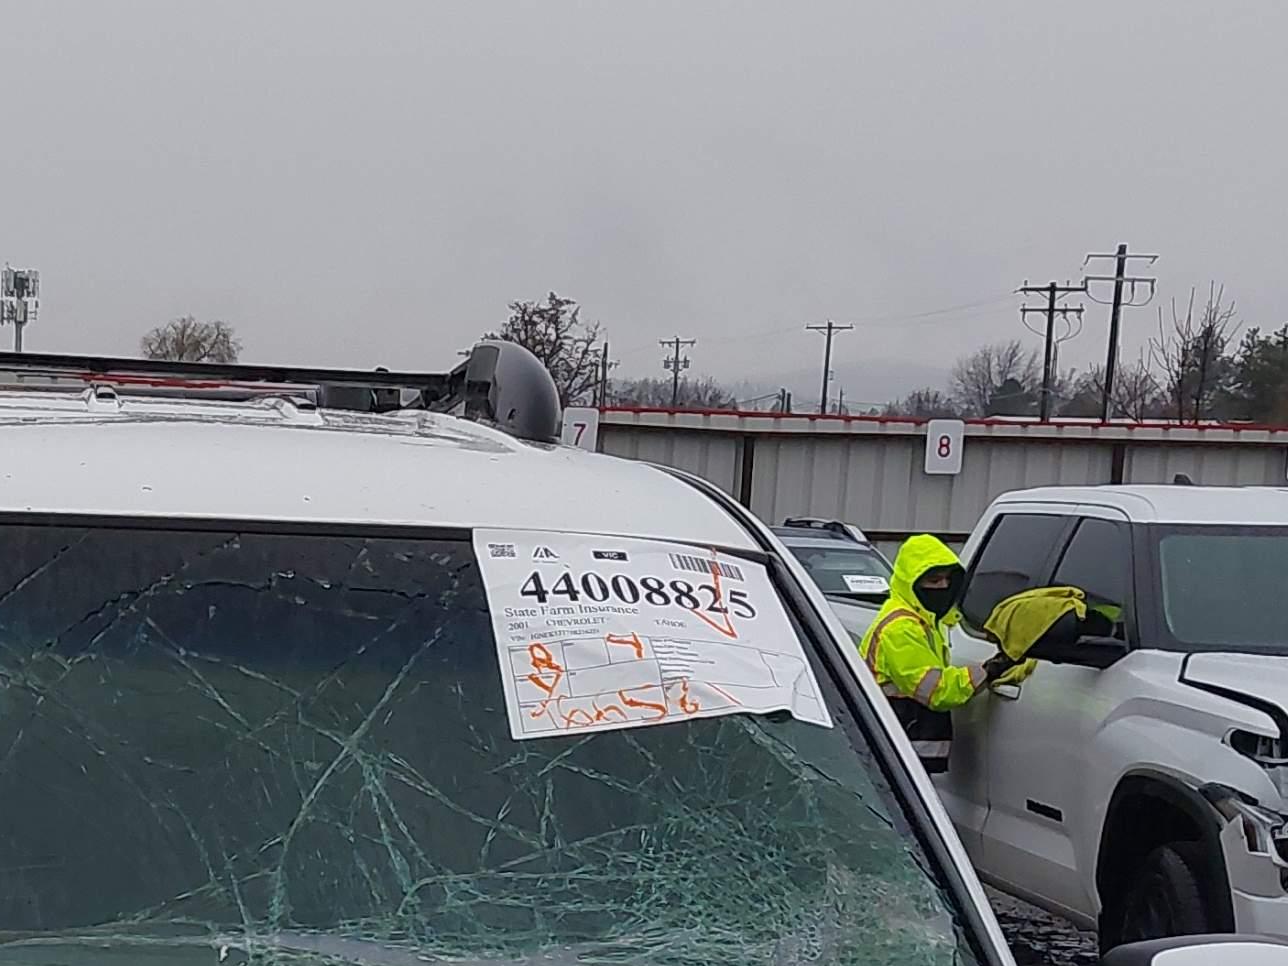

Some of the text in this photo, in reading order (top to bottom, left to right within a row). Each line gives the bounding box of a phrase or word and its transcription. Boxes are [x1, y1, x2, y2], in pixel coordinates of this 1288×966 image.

[573, 423, 587, 446] 7
[937, 435, 951, 458] 8
[520, 571, 756, 619] 44008825
[504, 604, 639, 617] State Farm Insurance
[508, 622, 529, 631] 2001
[546, 617, 605, 626] CHEVROLET
